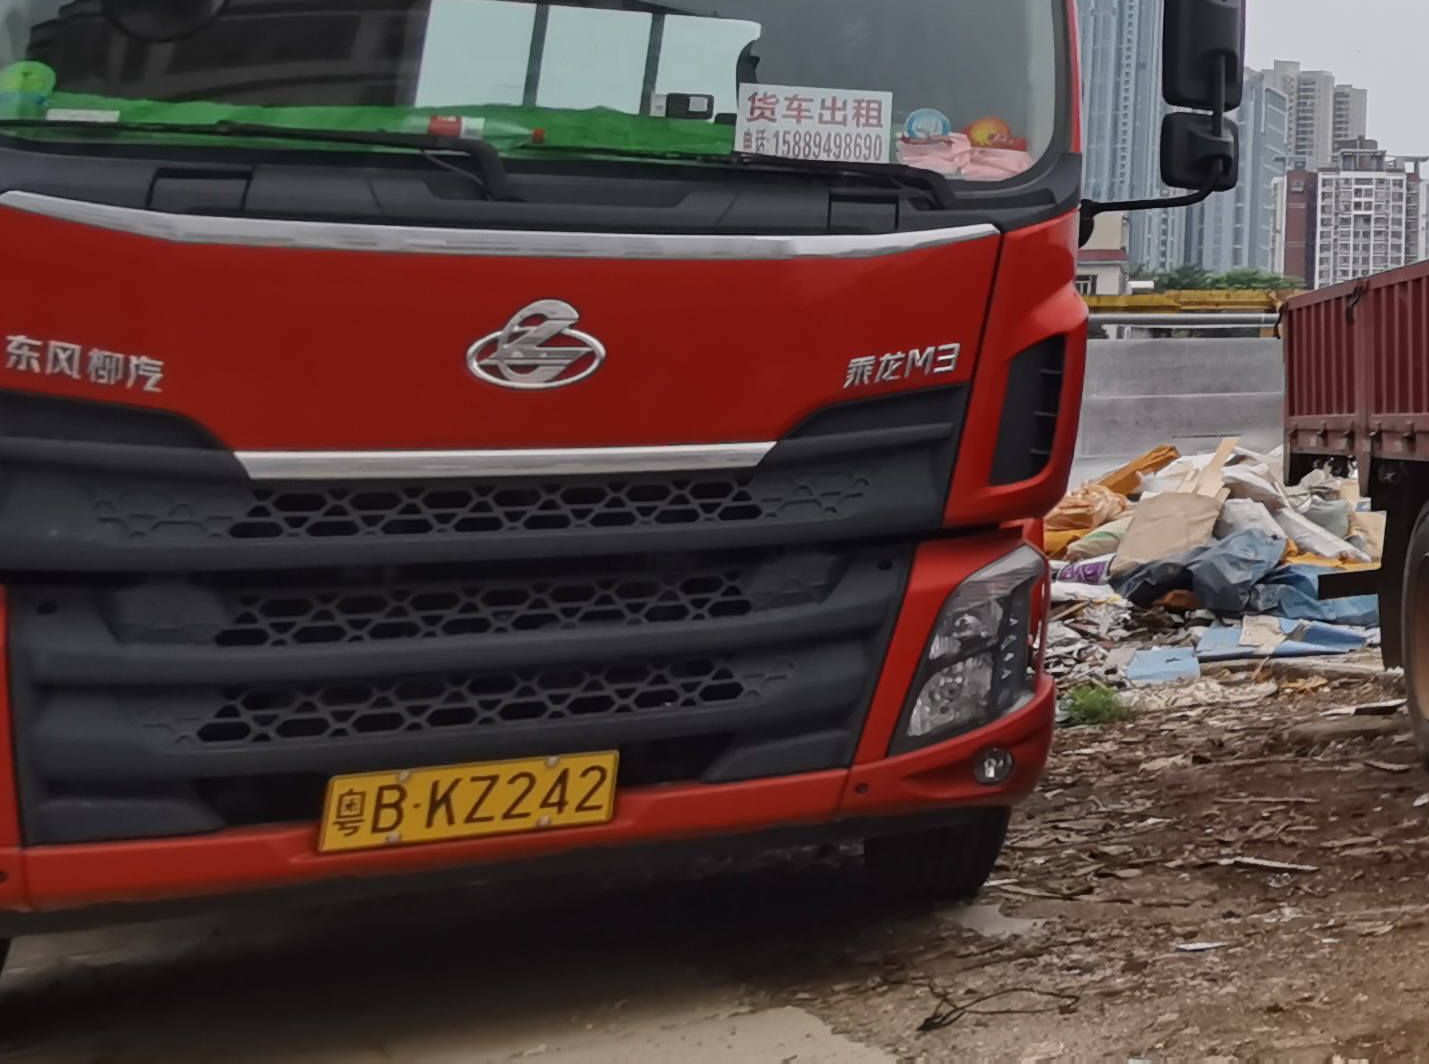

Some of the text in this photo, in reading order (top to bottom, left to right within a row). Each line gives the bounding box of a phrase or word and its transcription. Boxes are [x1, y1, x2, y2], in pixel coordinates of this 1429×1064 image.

[746, 91, 884, 128] 货车出租
[6, 335, 164, 392] 东风柳汽
[843, 342, 961, 389] 乘龙M3
